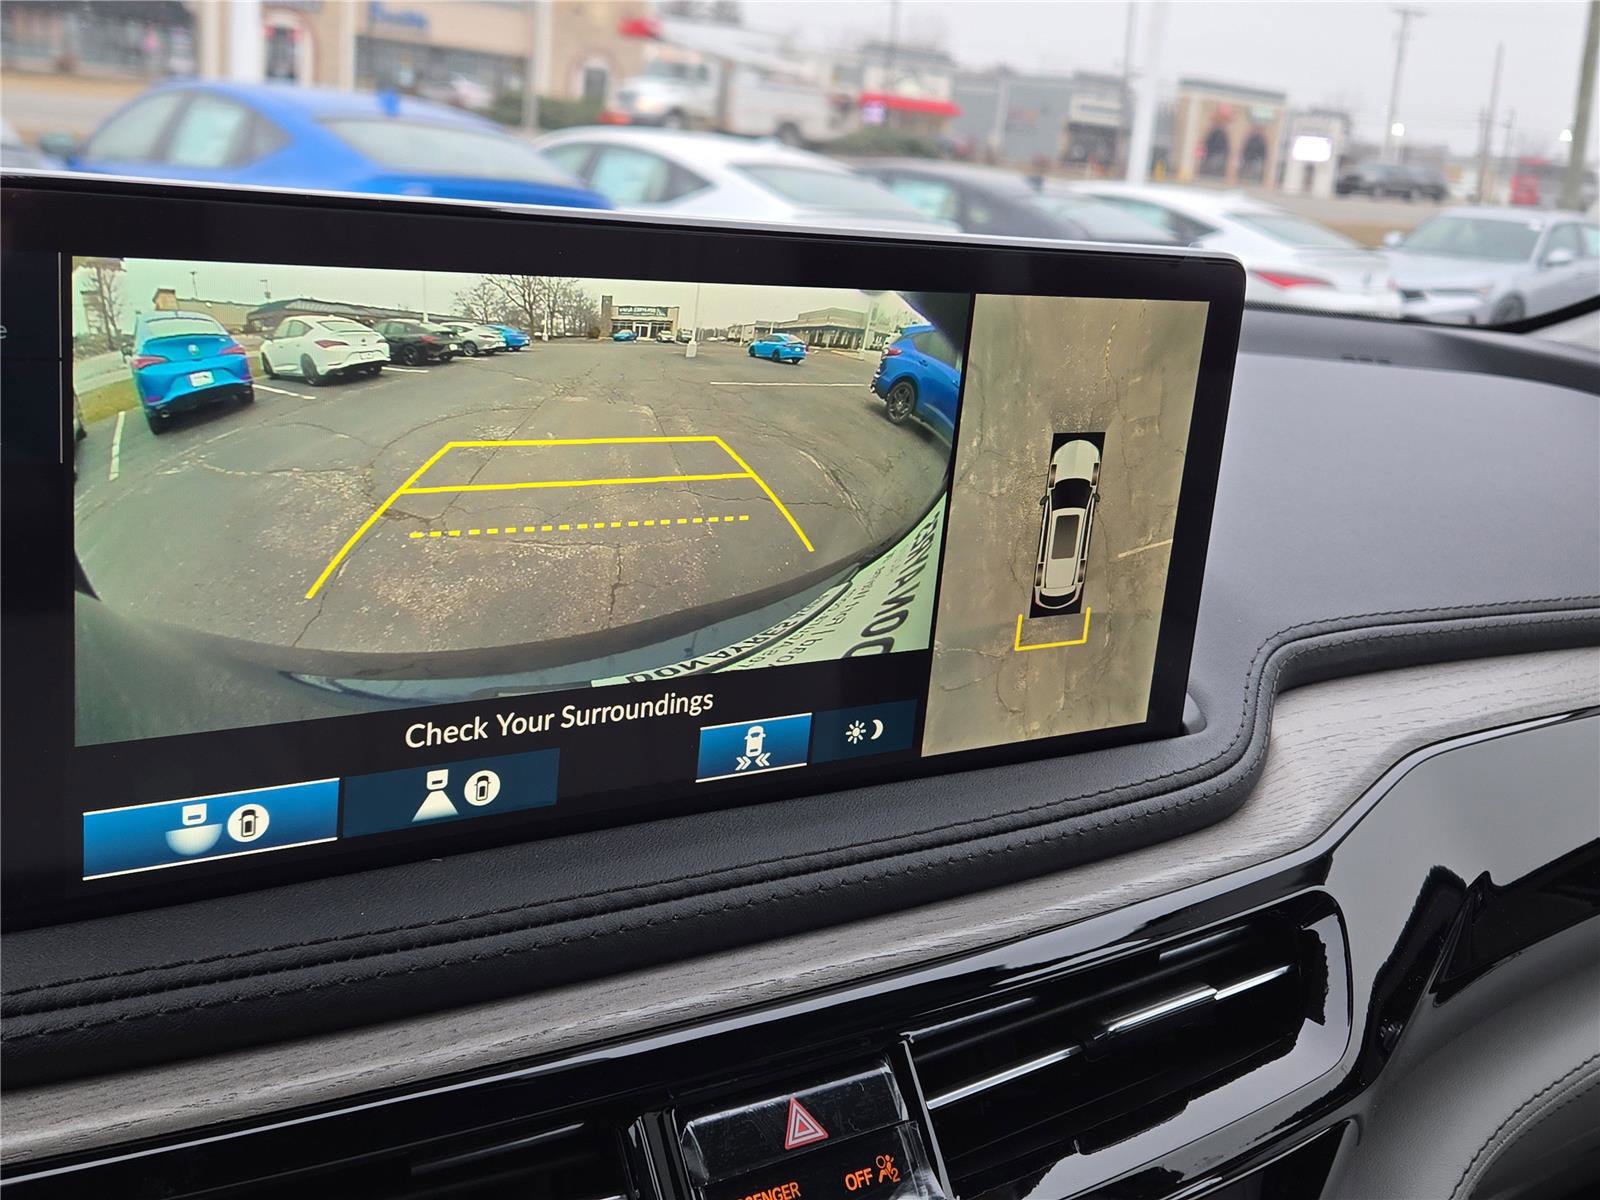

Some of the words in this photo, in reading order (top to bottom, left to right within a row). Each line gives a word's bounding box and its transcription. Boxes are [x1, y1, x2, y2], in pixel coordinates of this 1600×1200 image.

[404, 715, 488, 748] Check
[496, 711, 555, 736] Your
[560, 692, 714, 728] Surroundings
[845, 1167, 873, 1191] OFF
